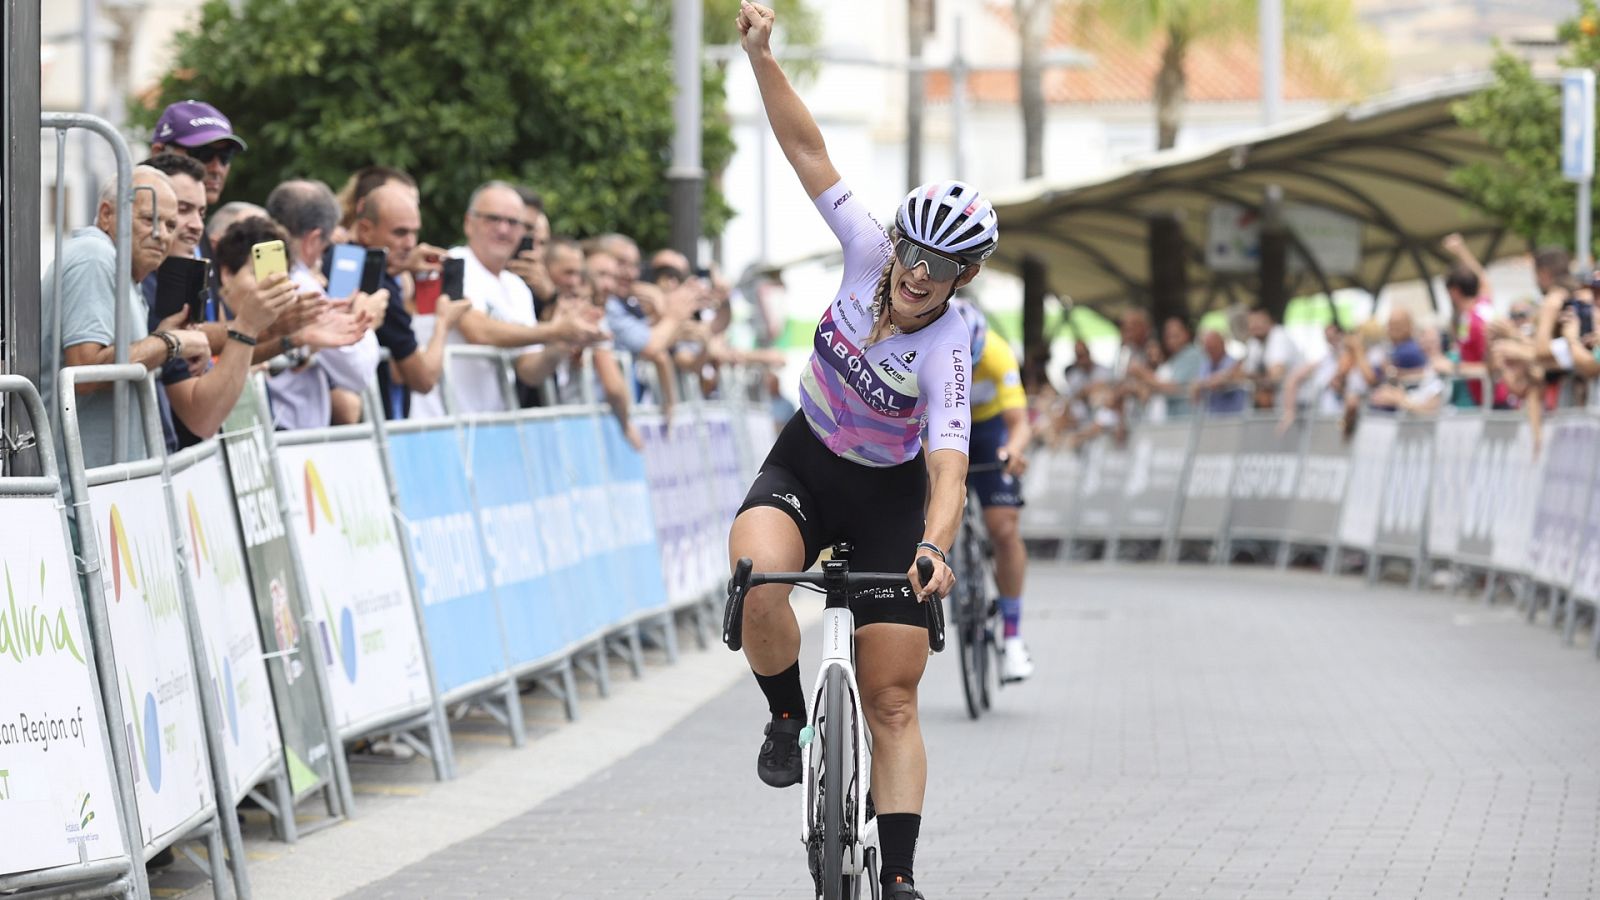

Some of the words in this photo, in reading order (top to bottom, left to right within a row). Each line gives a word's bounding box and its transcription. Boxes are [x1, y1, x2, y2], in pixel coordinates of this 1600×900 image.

[818, 316, 900, 411] LABORAL
[952, 349, 966, 409] LABORAL
[855, 380, 900, 417] kutxa
[944, 381, 954, 409] kutxa
[0, 722, 20, 746] an
[20, 712, 69, 753] Region
[70, 705, 86, 749] of
